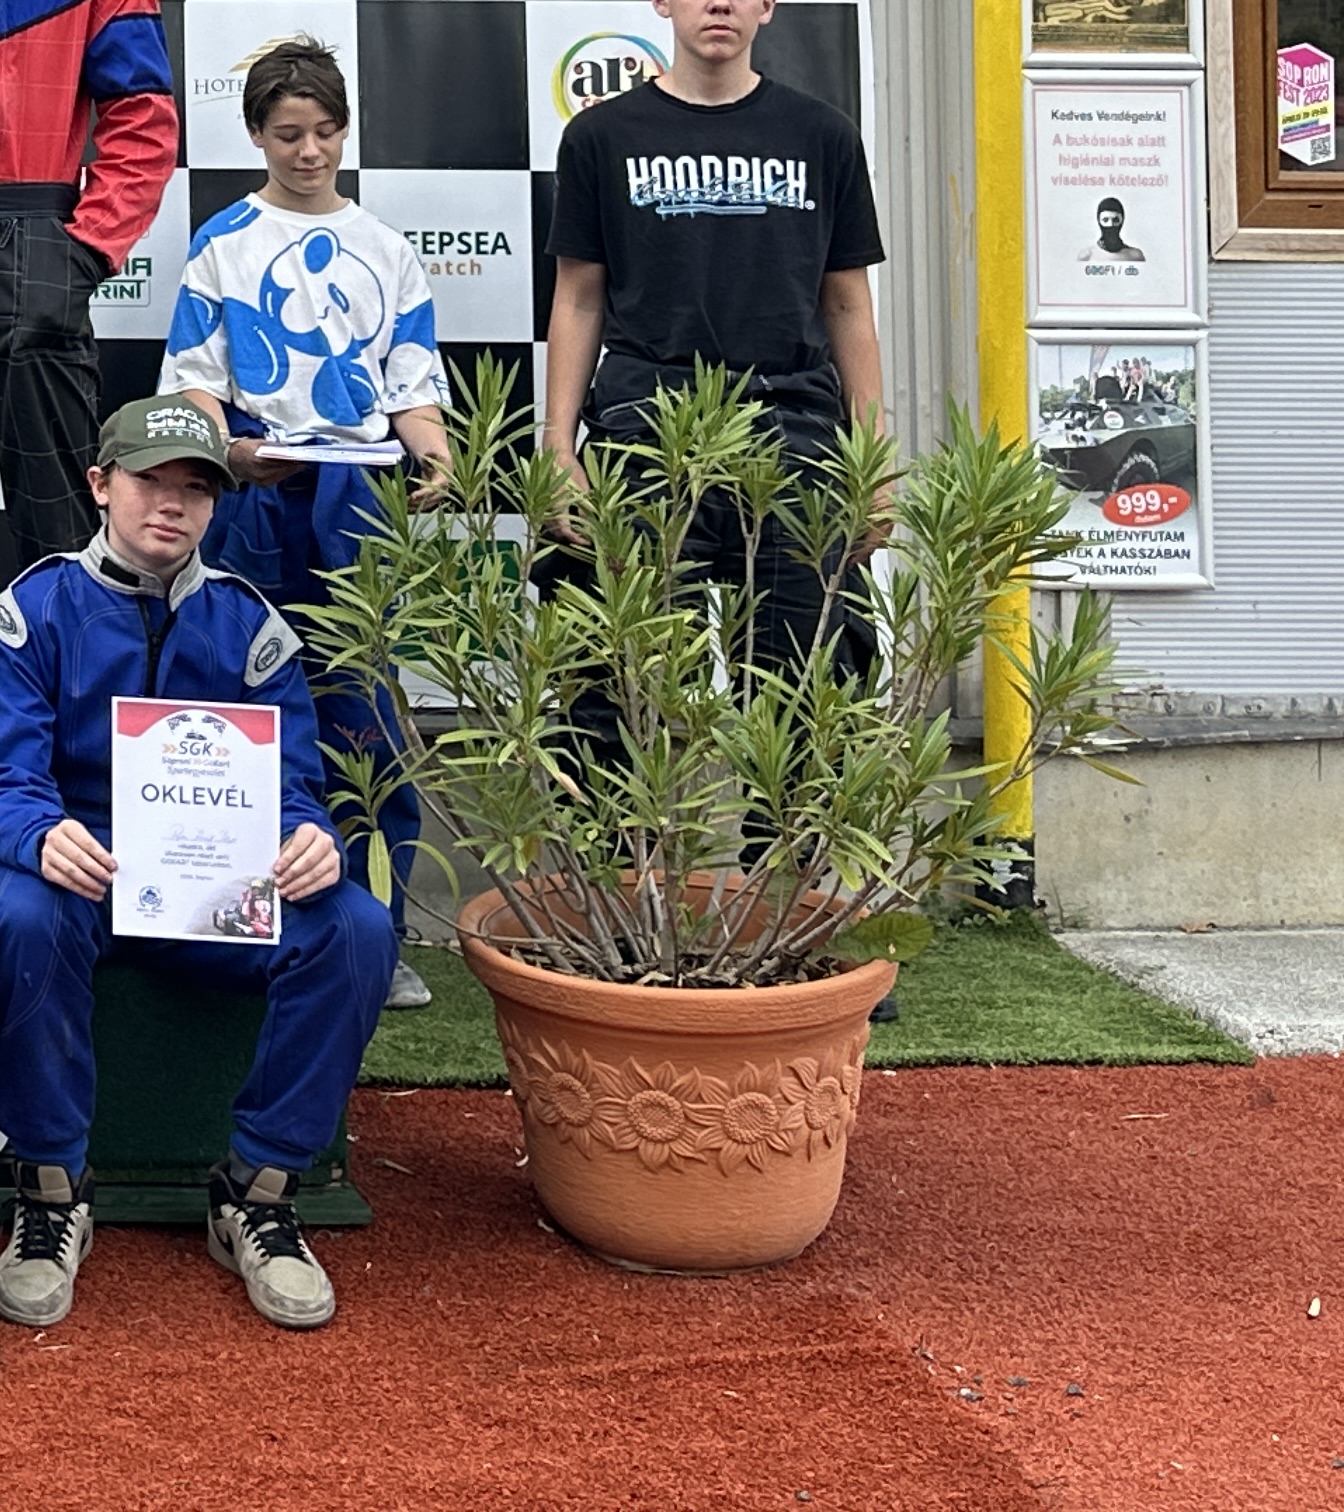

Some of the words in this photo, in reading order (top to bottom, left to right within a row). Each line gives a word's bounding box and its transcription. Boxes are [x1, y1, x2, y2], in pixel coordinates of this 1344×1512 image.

[193, 77, 245, 95] HOTE
[1051, 108, 1094, 123] Kedves
[1052, 134, 1062, 147] A
[423, 258, 483, 276] atch
[94, 279, 147, 300] RINT
[1116, 489, 1178, 516] 999,-
[1088, 527, 1185, 543] ÉLMÉNYFUTAM
[1097, 548, 1106, 559] A
[1110, 545, 1191, 560] KASSZÁBAN
[178, 741, 214, 757] SGK
[140, 782, 254, 809] OKLEVÉL
